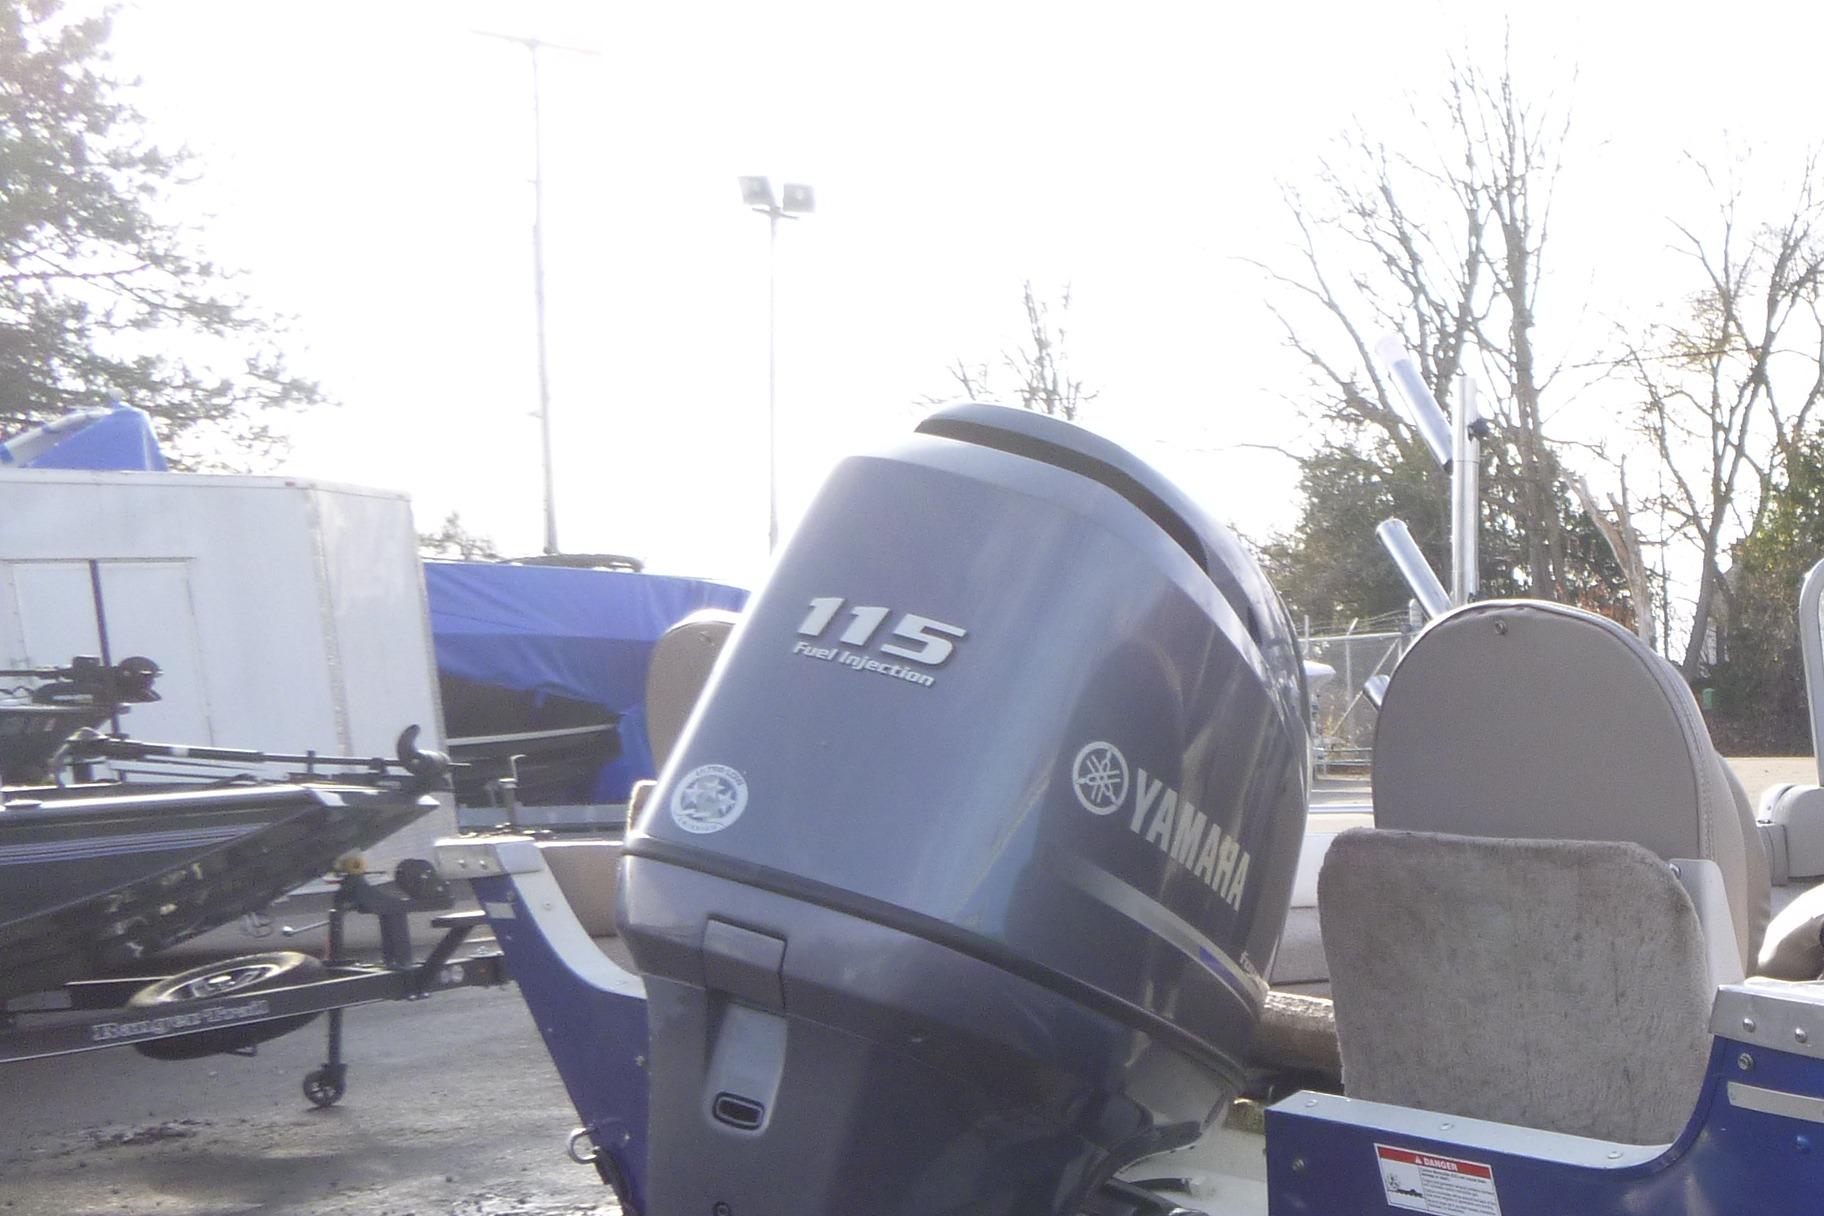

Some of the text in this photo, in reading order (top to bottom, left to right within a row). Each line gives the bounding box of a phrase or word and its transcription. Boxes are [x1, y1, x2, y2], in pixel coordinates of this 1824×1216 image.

[797, 597, 967, 665] 115
[793, 641, 935, 688] Fuel Injection
[1130, 767, 1250, 913] YAMAHA
[1423, 1155, 1459, 1172] DANGER
